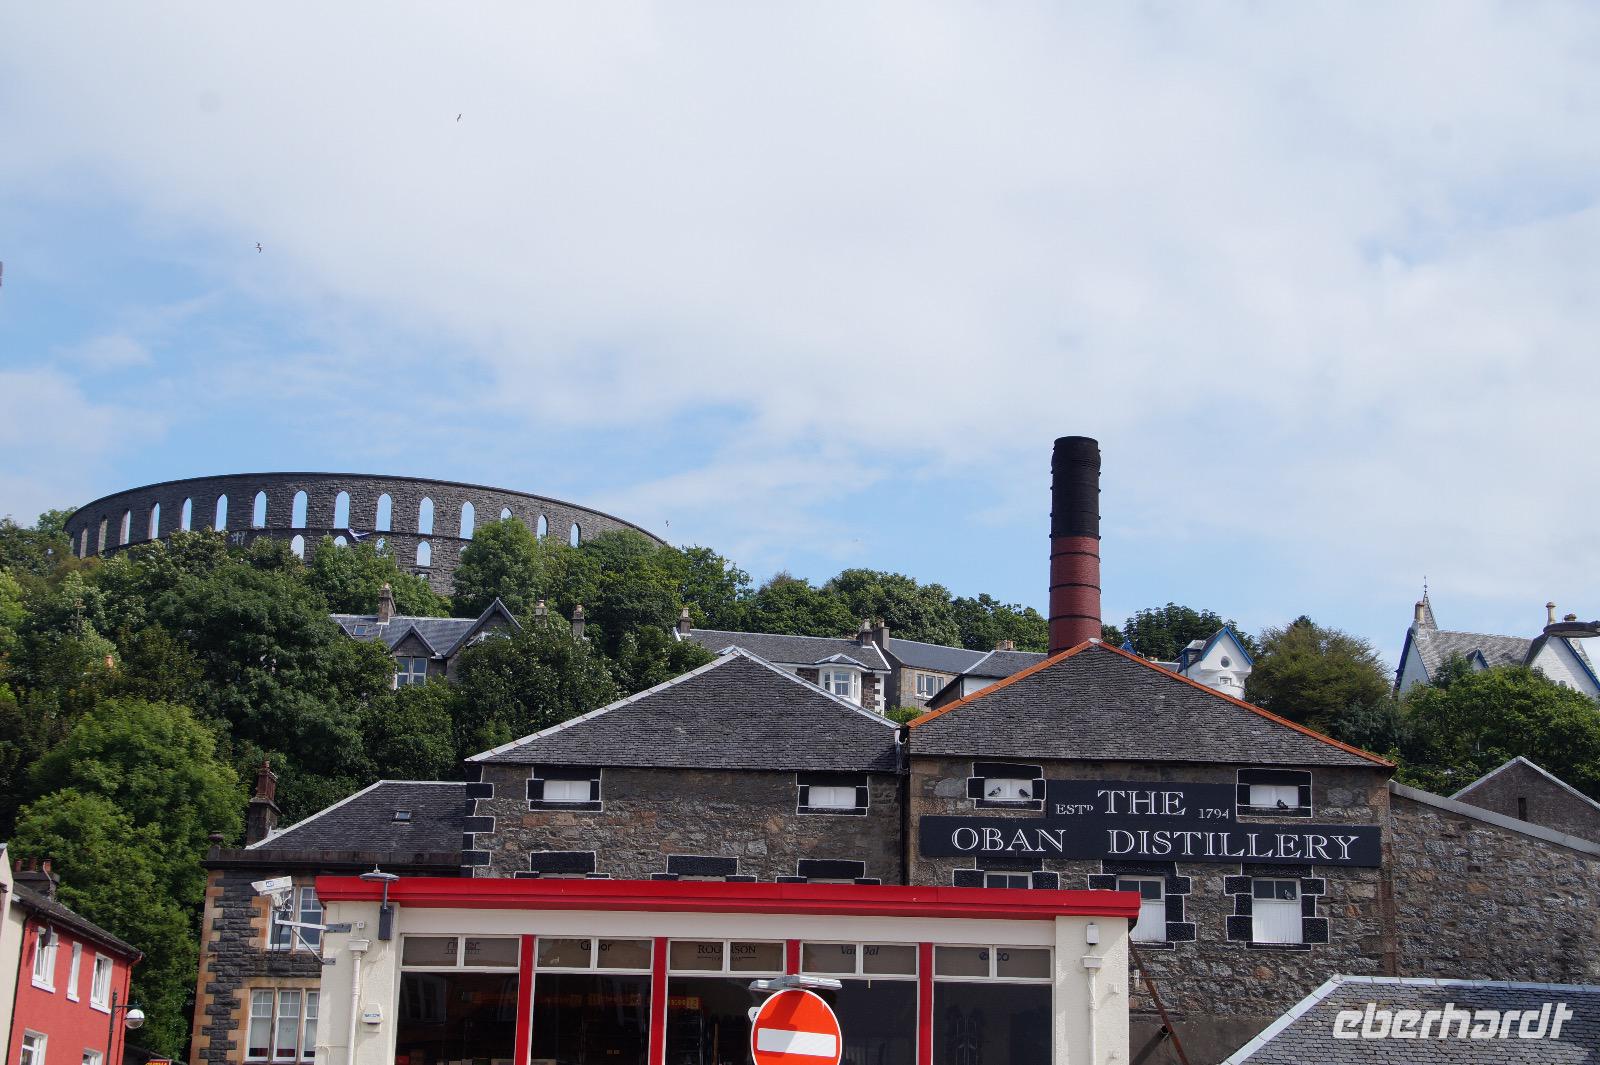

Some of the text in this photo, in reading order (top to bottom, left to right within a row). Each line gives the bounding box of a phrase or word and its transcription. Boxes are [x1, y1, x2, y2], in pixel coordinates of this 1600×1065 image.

[1097, 789, 1186, 816] THE
[1198, 808, 1230, 820] 1794
[951, 827, 1360, 860] OBAN DISTILLERY
